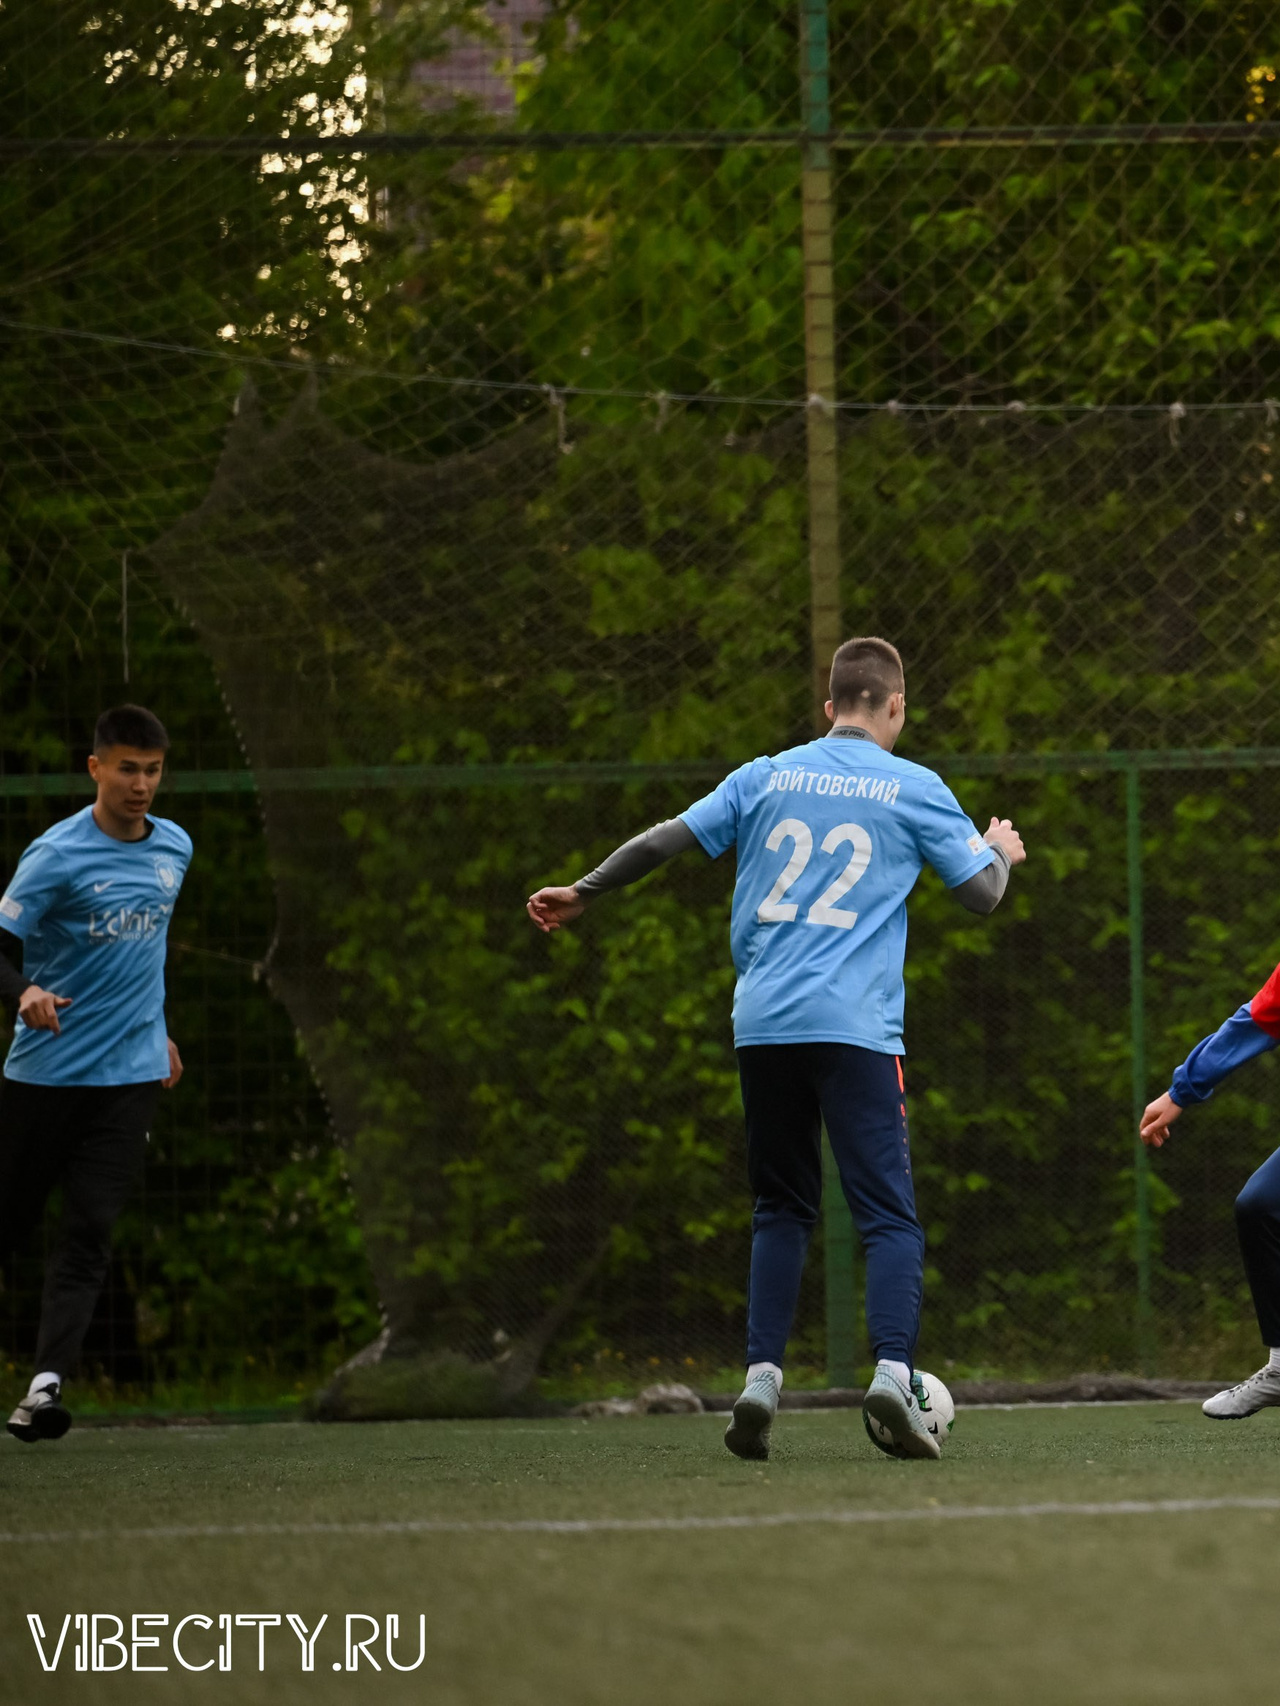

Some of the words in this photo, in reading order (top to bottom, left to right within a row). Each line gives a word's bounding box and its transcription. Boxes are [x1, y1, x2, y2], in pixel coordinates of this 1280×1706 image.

[849, 730, 865, 738] PRO
[766, 766, 900, 805] ВОЙТОВСКИЙ
[757, 818, 872, 929] 22
